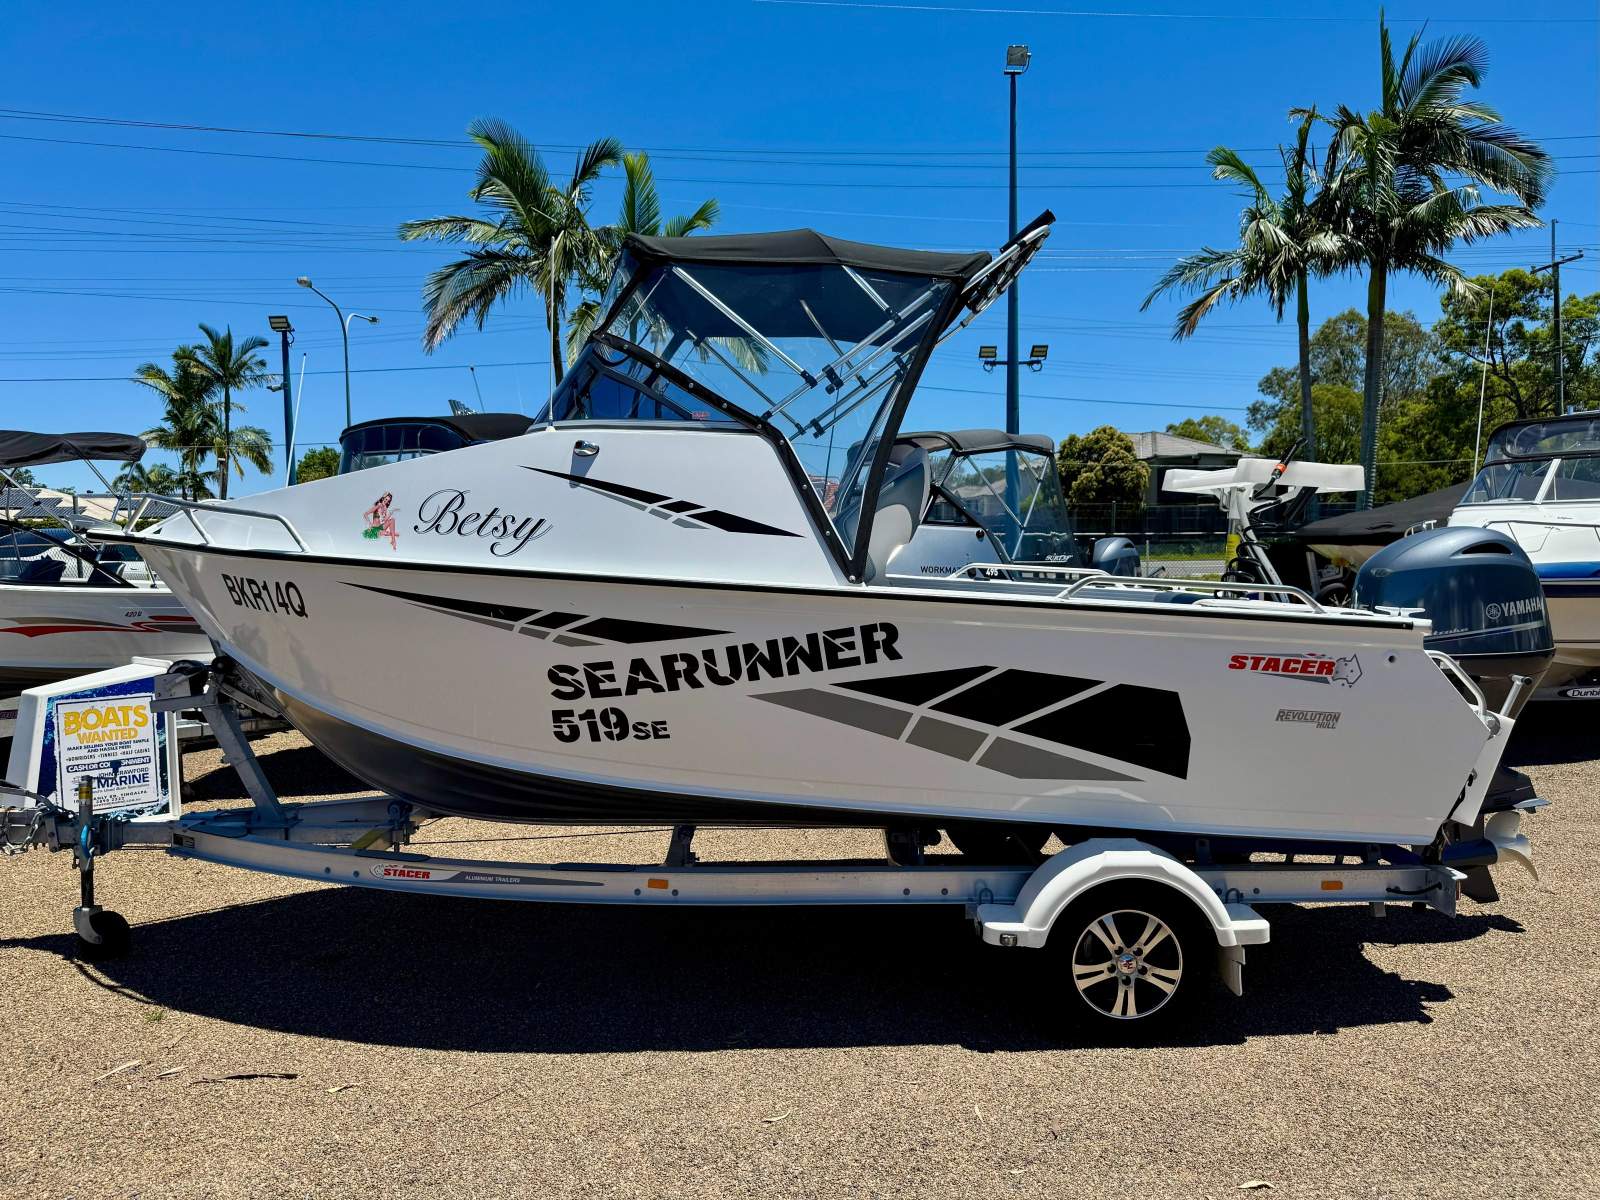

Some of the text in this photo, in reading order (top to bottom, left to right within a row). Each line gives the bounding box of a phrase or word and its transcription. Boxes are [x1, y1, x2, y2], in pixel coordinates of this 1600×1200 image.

[413, 488, 553, 557] Betsy
[221, 573, 308, 618] BKR14Q
[1502, 597, 1544, 617] YAMAHA
[547, 622, 903, 701] SEARUNNER
[1228, 655, 1336, 676] STACER
[64, 705, 149, 736] BOATS
[1275, 708, 1341, 723] REVOLUTION
[1316, 721, 1337, 729] HULL
[77, 728, 138, 744] WANTED
[68, 764, 88, 772] CASH
[97, 773, 149, 788] MARINE
[384, 868, 430, 879] STACER
